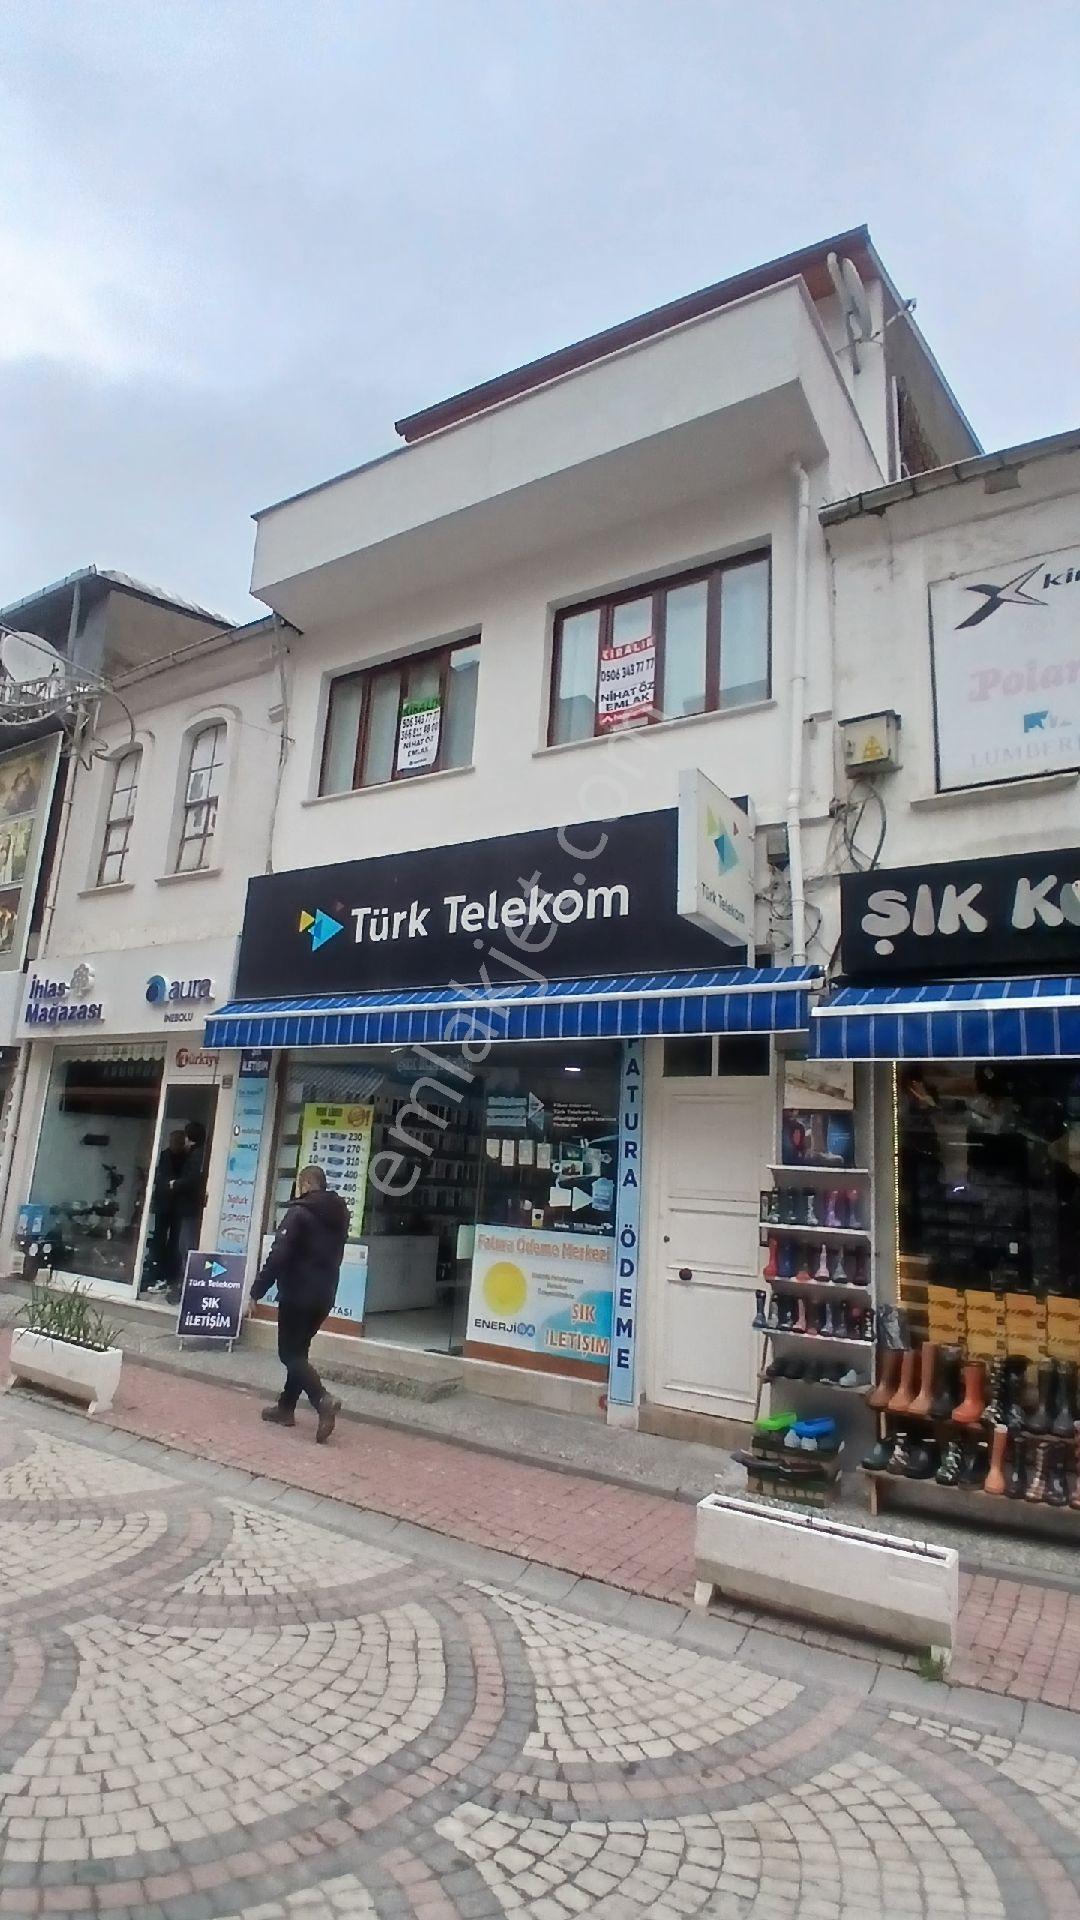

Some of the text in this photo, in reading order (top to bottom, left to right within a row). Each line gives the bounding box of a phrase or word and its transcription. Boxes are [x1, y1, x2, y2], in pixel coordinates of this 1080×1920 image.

[601, 669, 620, 682] 0506
[622, 664, 635, 678] 343
[636, 661, 644, 673] 77
[600, 680, 655, 702] NİHAT ÖZ
[606, 692, 650, 711] EMLAK
[970, 733, 1080, 768] LUMBER
[351, 884, 629, 943] Türk Telekom
[701, 881, 745, 924] Türk Telekom
[861, 884, 988, 956] ŞIK
[29, 975, 67, 999] İhlas
[169, 978, 213, 1000] aura
[25, 1002, 102, 1025] Mağazası
[348, 1132, 363, 1141] 230
[346, 1145, 360, 1154] 270
[478, 1233, 514, 1253] Fatura
[516, 1235, 560, 1257] Ödeme
[189, 1279, 241, 1290] Türk Telekom
[202, 1297, 220, 1311] ŞIK
[617, 1224, 637, 1369] ÖDEME
[184, 1311, 231, 1329] İLETİŞİM
[331, 1306, 353, 1317] TASI
